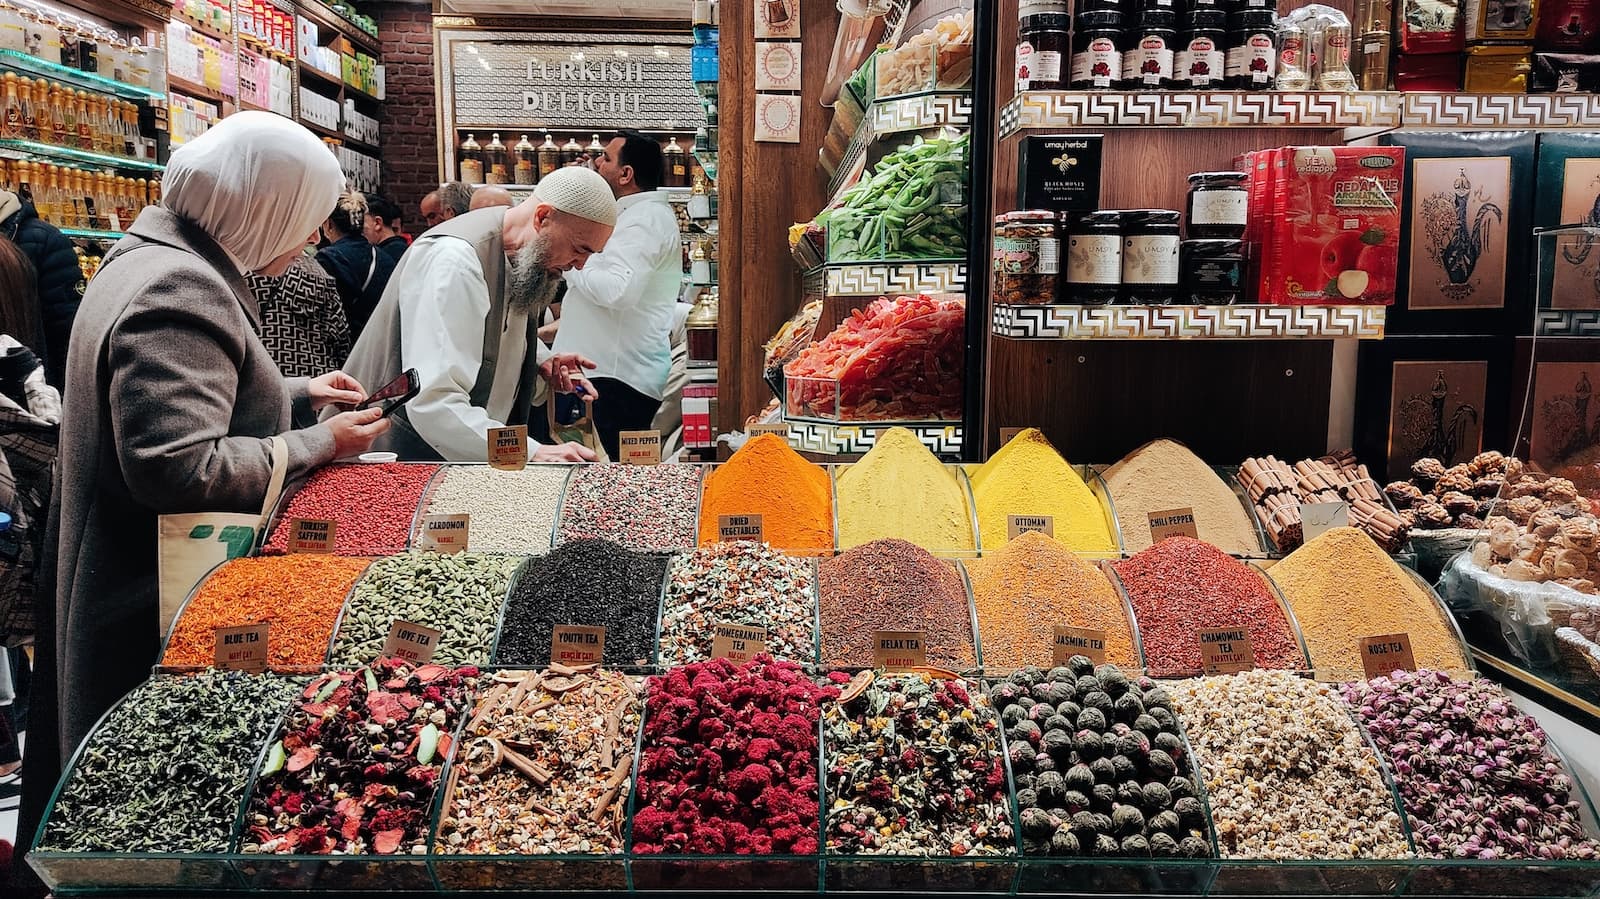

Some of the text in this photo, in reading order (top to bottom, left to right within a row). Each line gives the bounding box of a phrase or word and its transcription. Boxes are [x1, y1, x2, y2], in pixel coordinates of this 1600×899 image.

[524, 60, 643, 81] TURKISH
[522, 91, 645, 112] DELIGHT
[1044, 140, 1087, 150] umay herbal
[1304, 156, 1326, 165] TEA
[1335, 181, 1359, 192] RED
[499, 430, 517, 438] WHITE
[496, 438, 519, 446] PEPPER
[639, 436, 658, 445] PEPPER
[428, 520, 465, 529] CARDOMON
[729, 517, 749, 526] DRIED
[1015, 518, 1046, 527] OTTOMAN
[1169, 514, 1194, 525] PEPPER
[300, 521, 329, 531] TURKISH
[720, 526, 760, 535] VEGETABLES
[297, 531, 327, 541] SAFFRON
[224, 632, 259, 645] BLUE TEA
[396, 628, 430, 646] LOVE TEA
[559, 632, 599, 644] YOUTH TEA
[717, 627, 765, 641] POMEGRANATE
[1200, 630, 1245, 642] CHAMOMILE
[732, 640, 745, 650] TEA
[881, 639, 920, 650] RELAX TEA
[1055, 635, 1104, 650] JASMINE TEA
[1218, 643, 1234, 653] TEA
[1368, 642, 1403, 655] ROSE TEA
